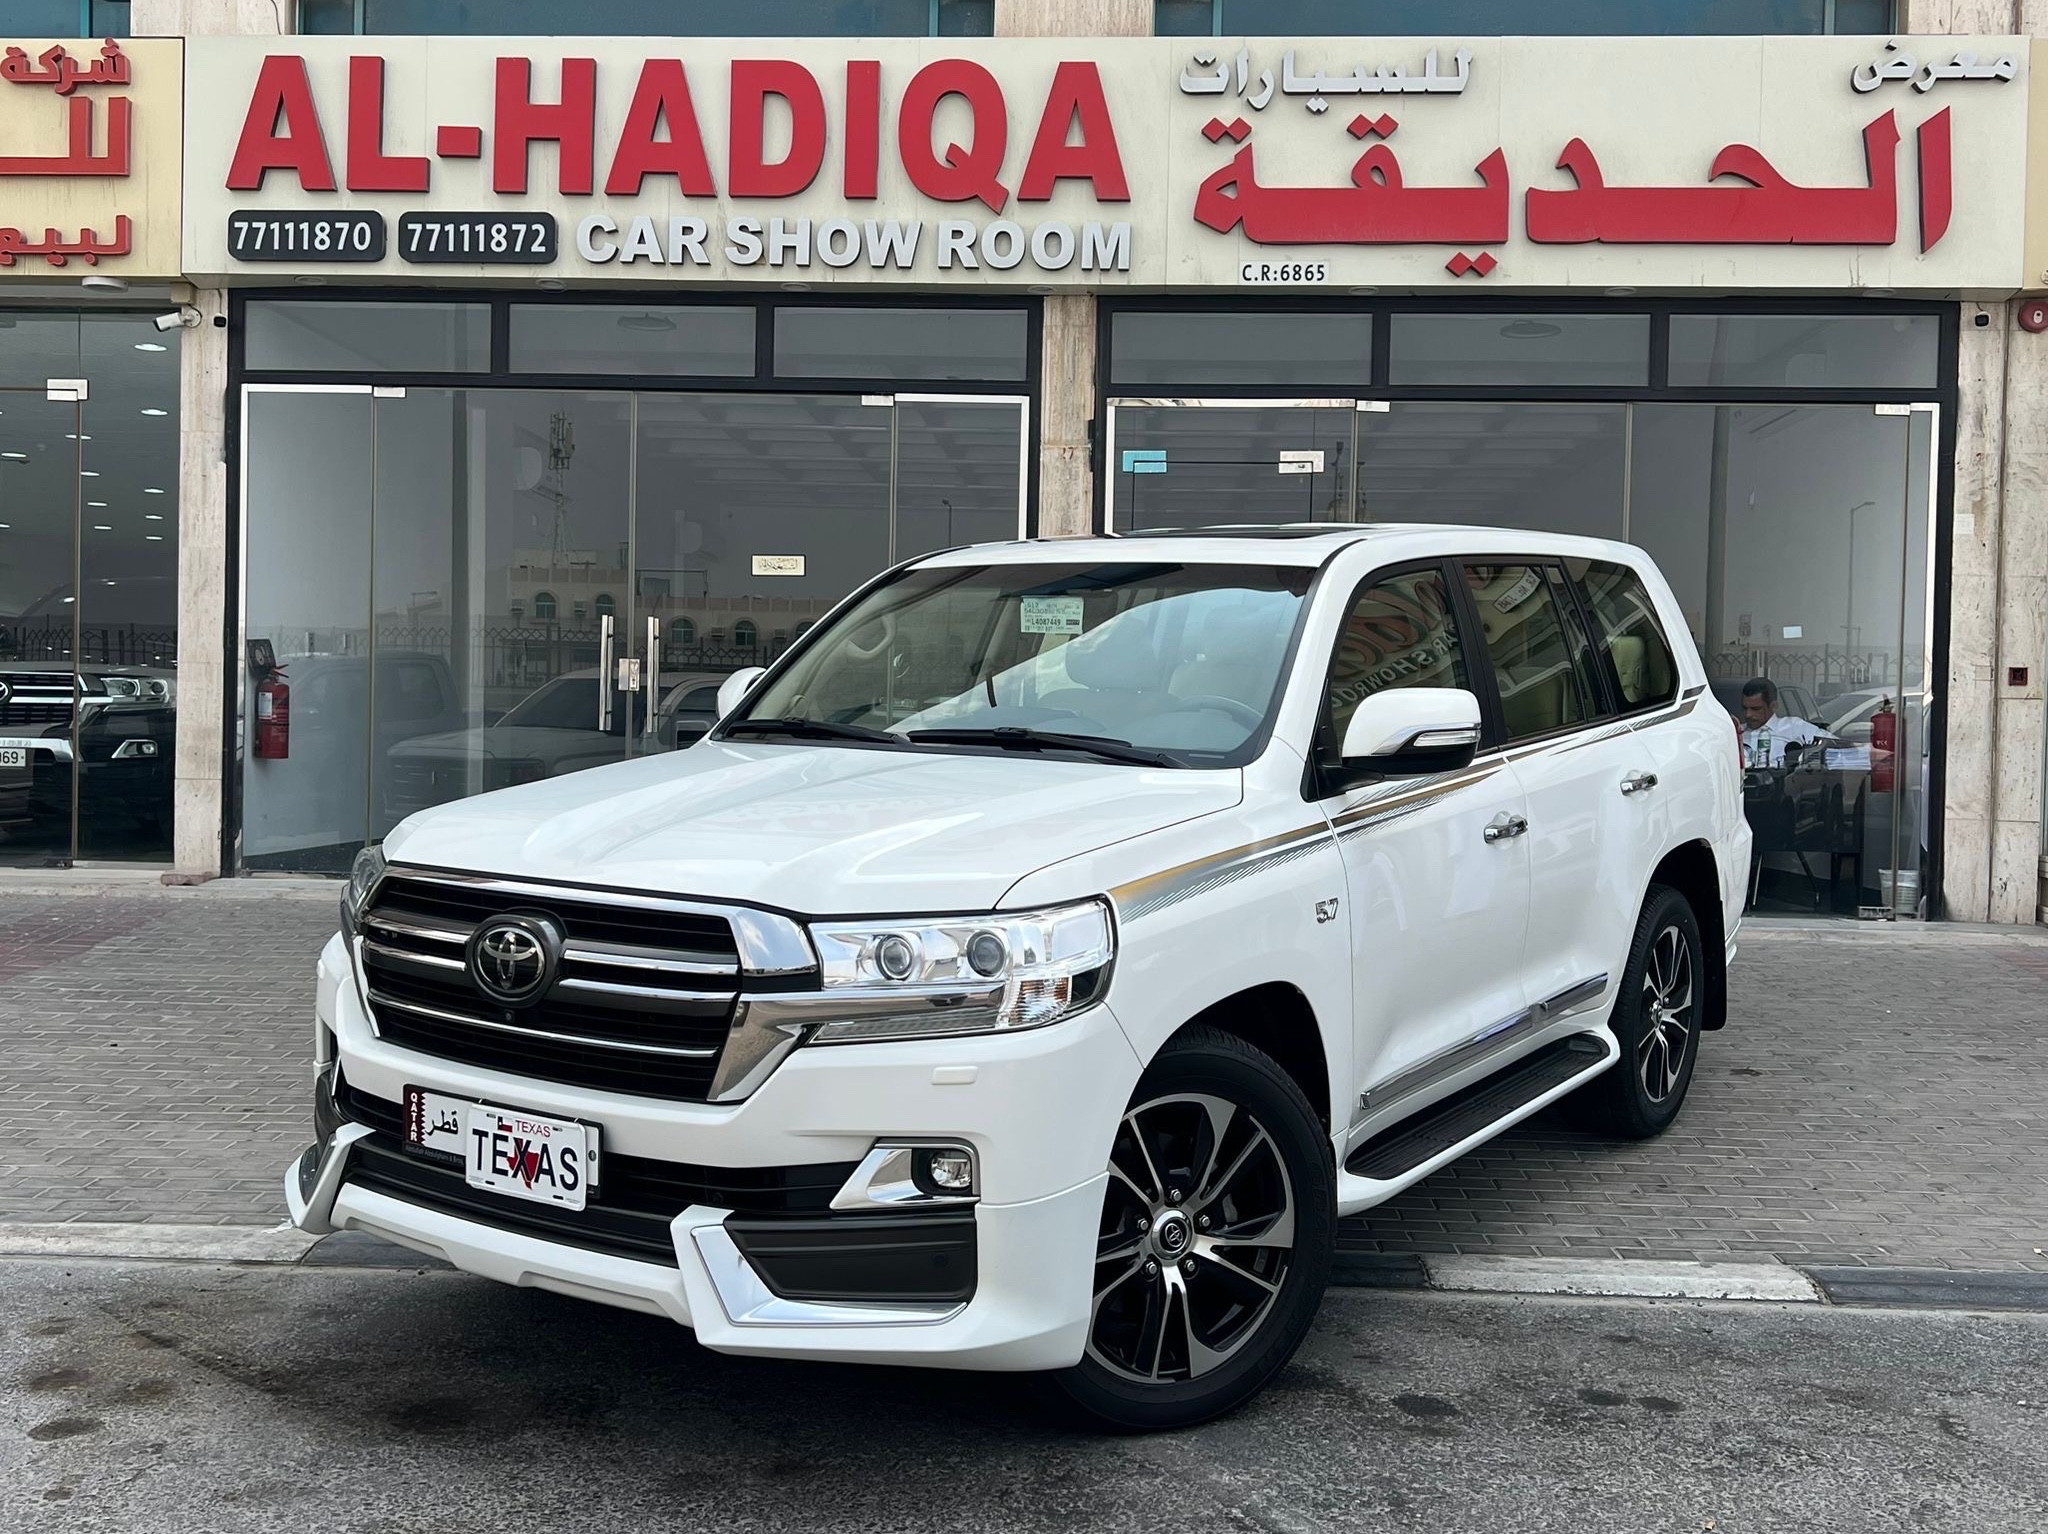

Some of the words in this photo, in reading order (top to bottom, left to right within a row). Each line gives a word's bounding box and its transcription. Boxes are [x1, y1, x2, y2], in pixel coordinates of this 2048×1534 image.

[1, 38, 131, 95] شركة
[1179, 46, 1473, 114] للسيارات
[1850, 40, 2019, 93] معرض
[226, 55, 1131, 215] AL-HADIQA
[1193, 105, 1952, 279] الحديقة
[234, 221, 371, 252] 77111870
[407, 222, 546, 253] 77111872
[577, 213, 710, 265] CAR
[725, 215, 921, 268] SHOW
[938, 220, 1131, 270] ROOM
[1242, 264, 1325, 282] C.R:6865
[0, 751, 18, 764] 69
[409, 1092, 418, 1142] QATAR
[425, 1110, 458, 1136] قطر
[515, 1119, 551, 1138] TEXAS
[472, 1128, 579, 1191] TEXAS
